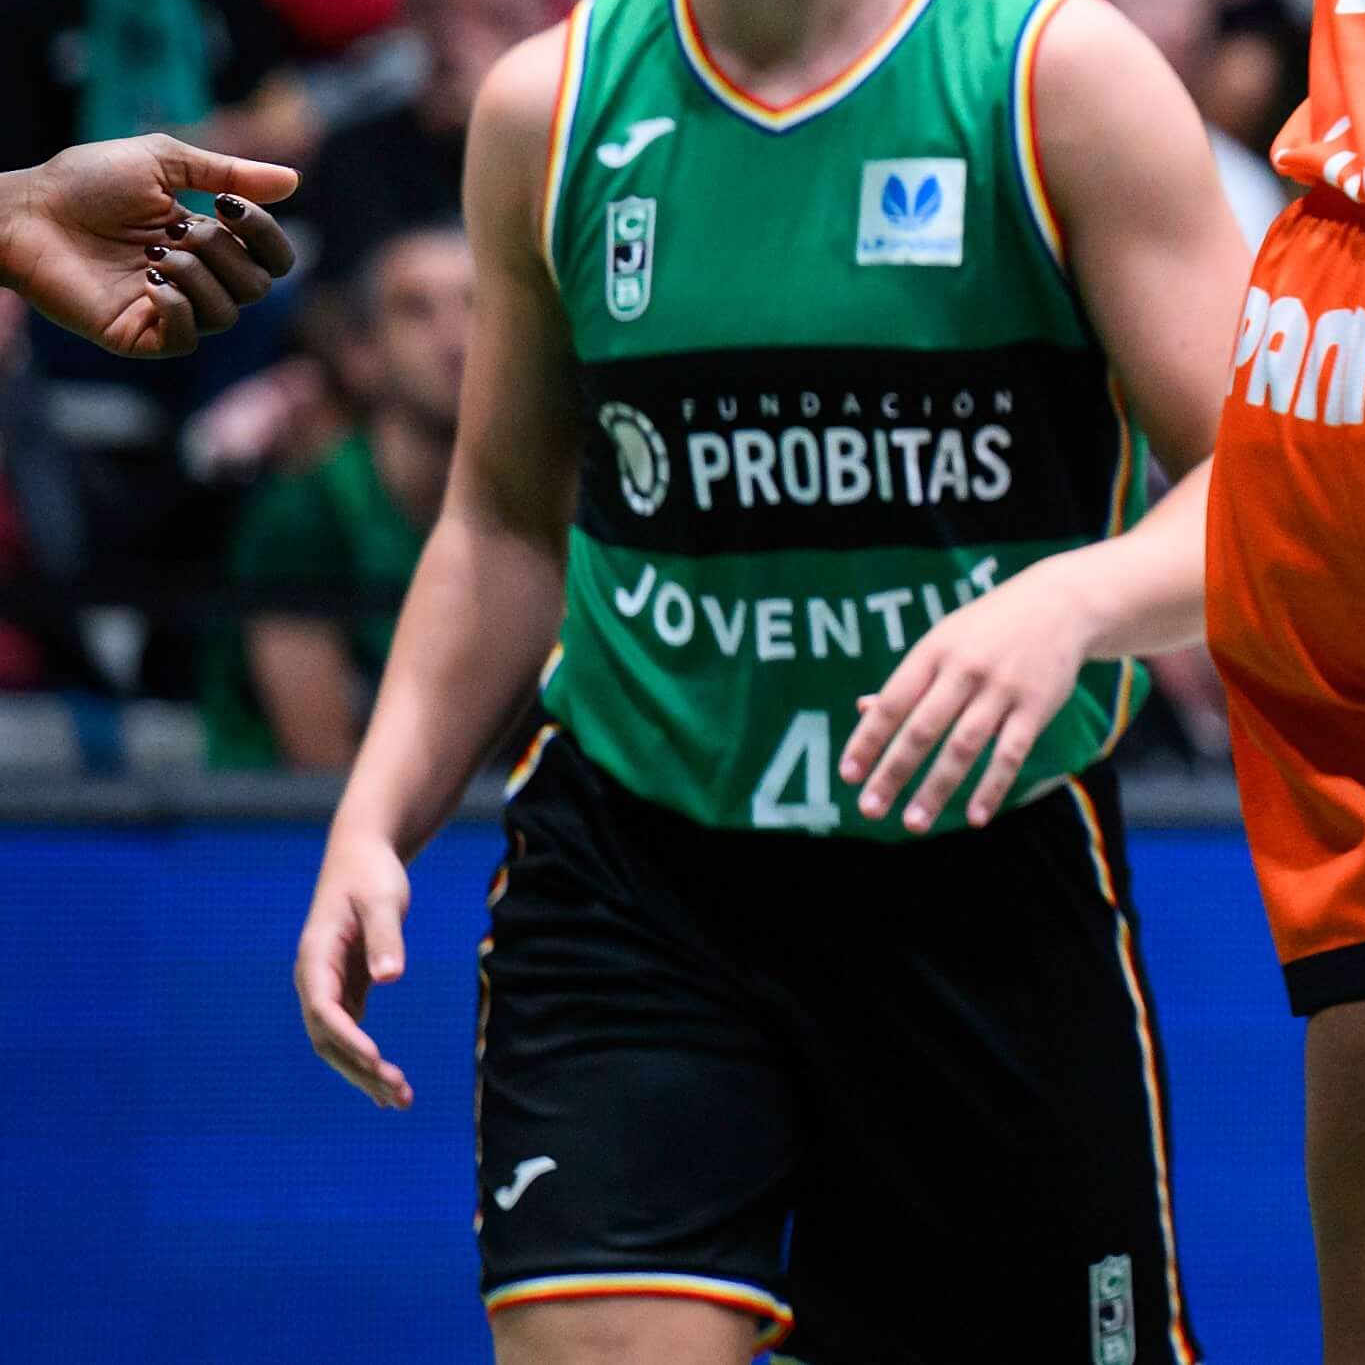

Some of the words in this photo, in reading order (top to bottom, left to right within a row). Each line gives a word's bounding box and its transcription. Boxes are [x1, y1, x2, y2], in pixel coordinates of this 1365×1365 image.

[682, 388, 1013, 424] FUNDACIÓN
[686, 424, 1013, 510] PROBITAS
[751, 709, 841, 836] 4
